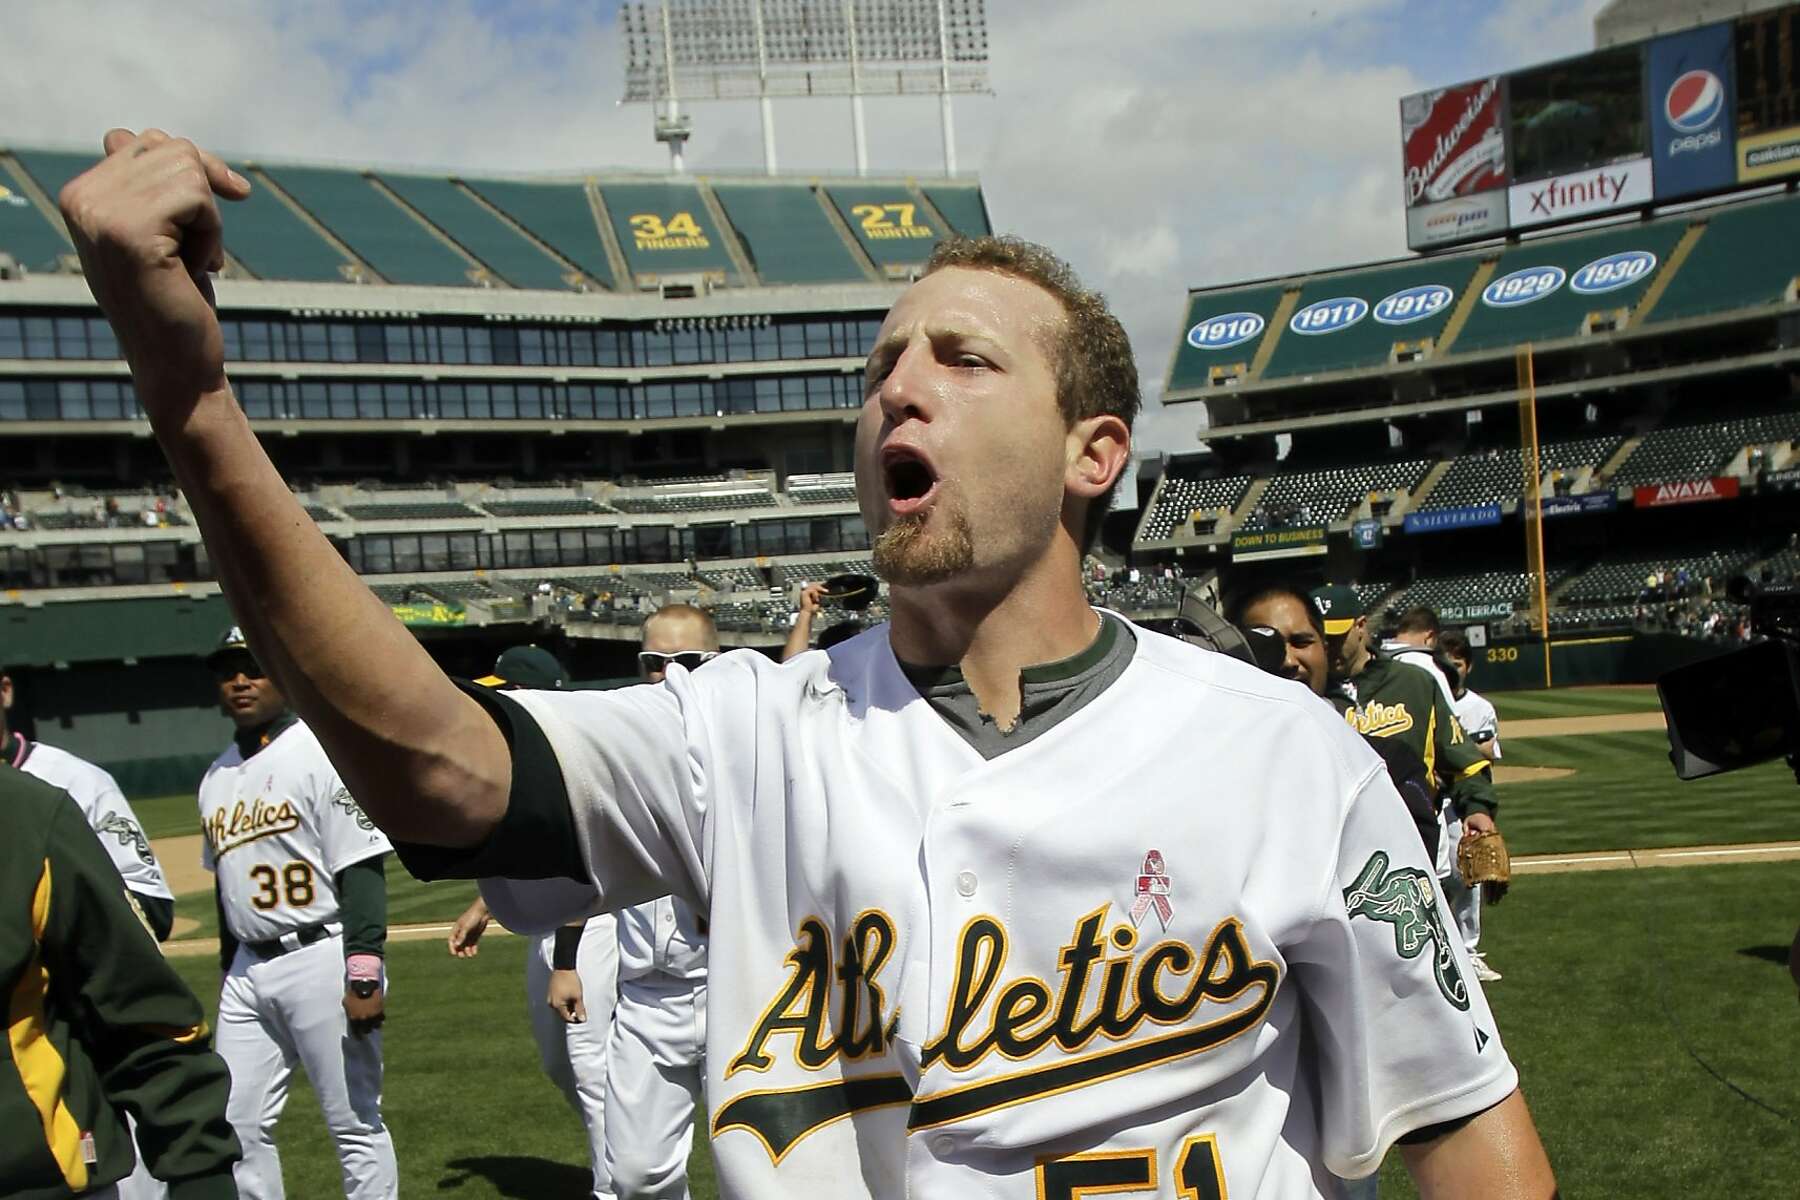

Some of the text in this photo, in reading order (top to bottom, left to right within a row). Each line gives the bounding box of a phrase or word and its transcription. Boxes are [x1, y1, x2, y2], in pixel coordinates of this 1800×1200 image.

[1406, 78, 1498, 208] Budweiser
[1669, 128, 1721, 157] pepsi
[1530, 173, 1628, 215] xfinity
[629, 212, 702, 239] 34
[852, 203, 916, 229] 27
[635, 236, 710, 249] FINGERS
[865, 226, 933, 239] HUNTER
[1583, 258, 1646, 284] 1930
[1494, 272, 1556, 301] 1929
[1301, 303, 1358, 328] 1911
[1384, 291, 1445, 316] 1913
[1198, 318, 1256, 341] 1910
[1656, 480, 1716, 500] AVAYA
[1424, 510, 1497, 527] SILVERADO
[1234, 528, 1325, 547] DOWN TO BUSINESS
[1441, 602, 1513, 619] BBQ TERRACE
[1487, 647, 1517, 662] 330
[249, 858, 317, 911] 38
[722, 902, 1282, 1082] Athletics
